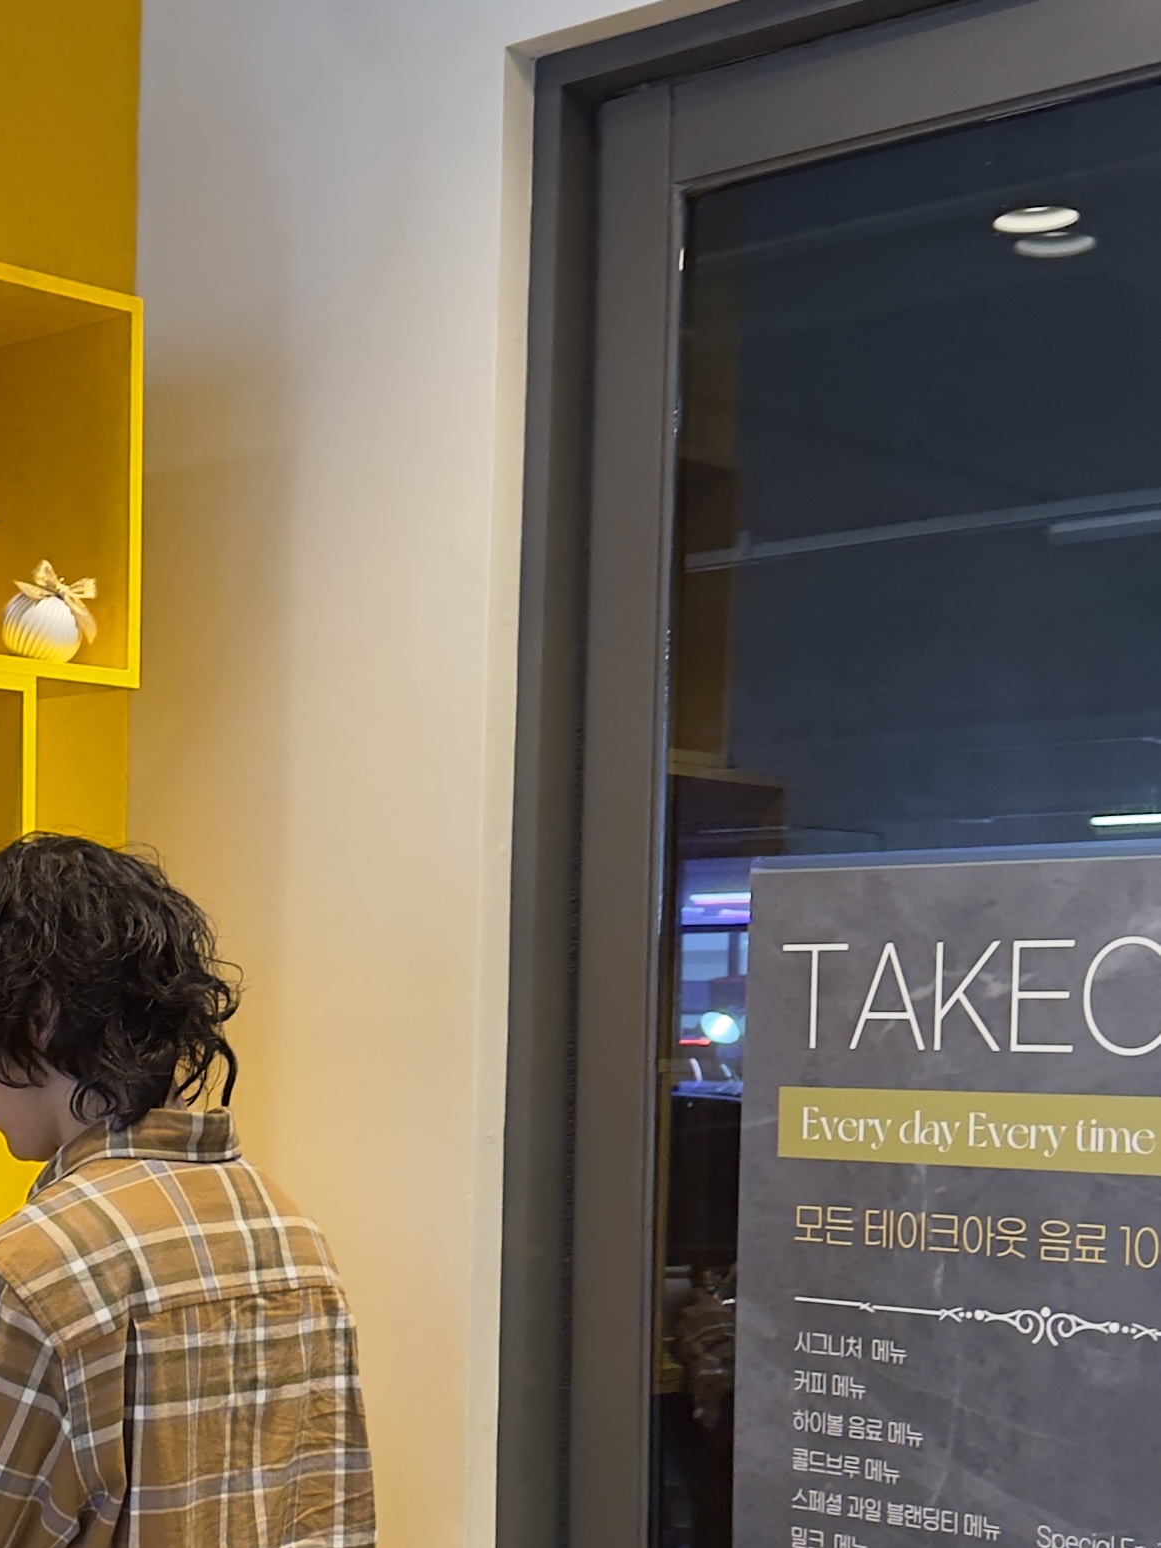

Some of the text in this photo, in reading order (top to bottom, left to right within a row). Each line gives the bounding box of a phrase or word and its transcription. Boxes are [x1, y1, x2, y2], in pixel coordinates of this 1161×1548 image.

[802, 1106, 1156, 1158] Every day Every time
[794, 1205, 854, 1246] 모든
[864, 1209, 1028, 1259] 테이크아웃
[1039, 1219, 1107, 1264] 음료
[794, 1331, 908, 1365] 시그니처 메뉴
[793, 1369, 867, 1400] 커피 메뉴
[792, 1409, 924, 1448] 하이볼 음료 메뉴
[792, 1447, 900, 1485] 콜드브루 메뉴
[791, 1488, 842, 1516] 스페셜
[846, 1495, 881, 1523] 과일
[963, 1513, 1001, 1542] 메뉴
